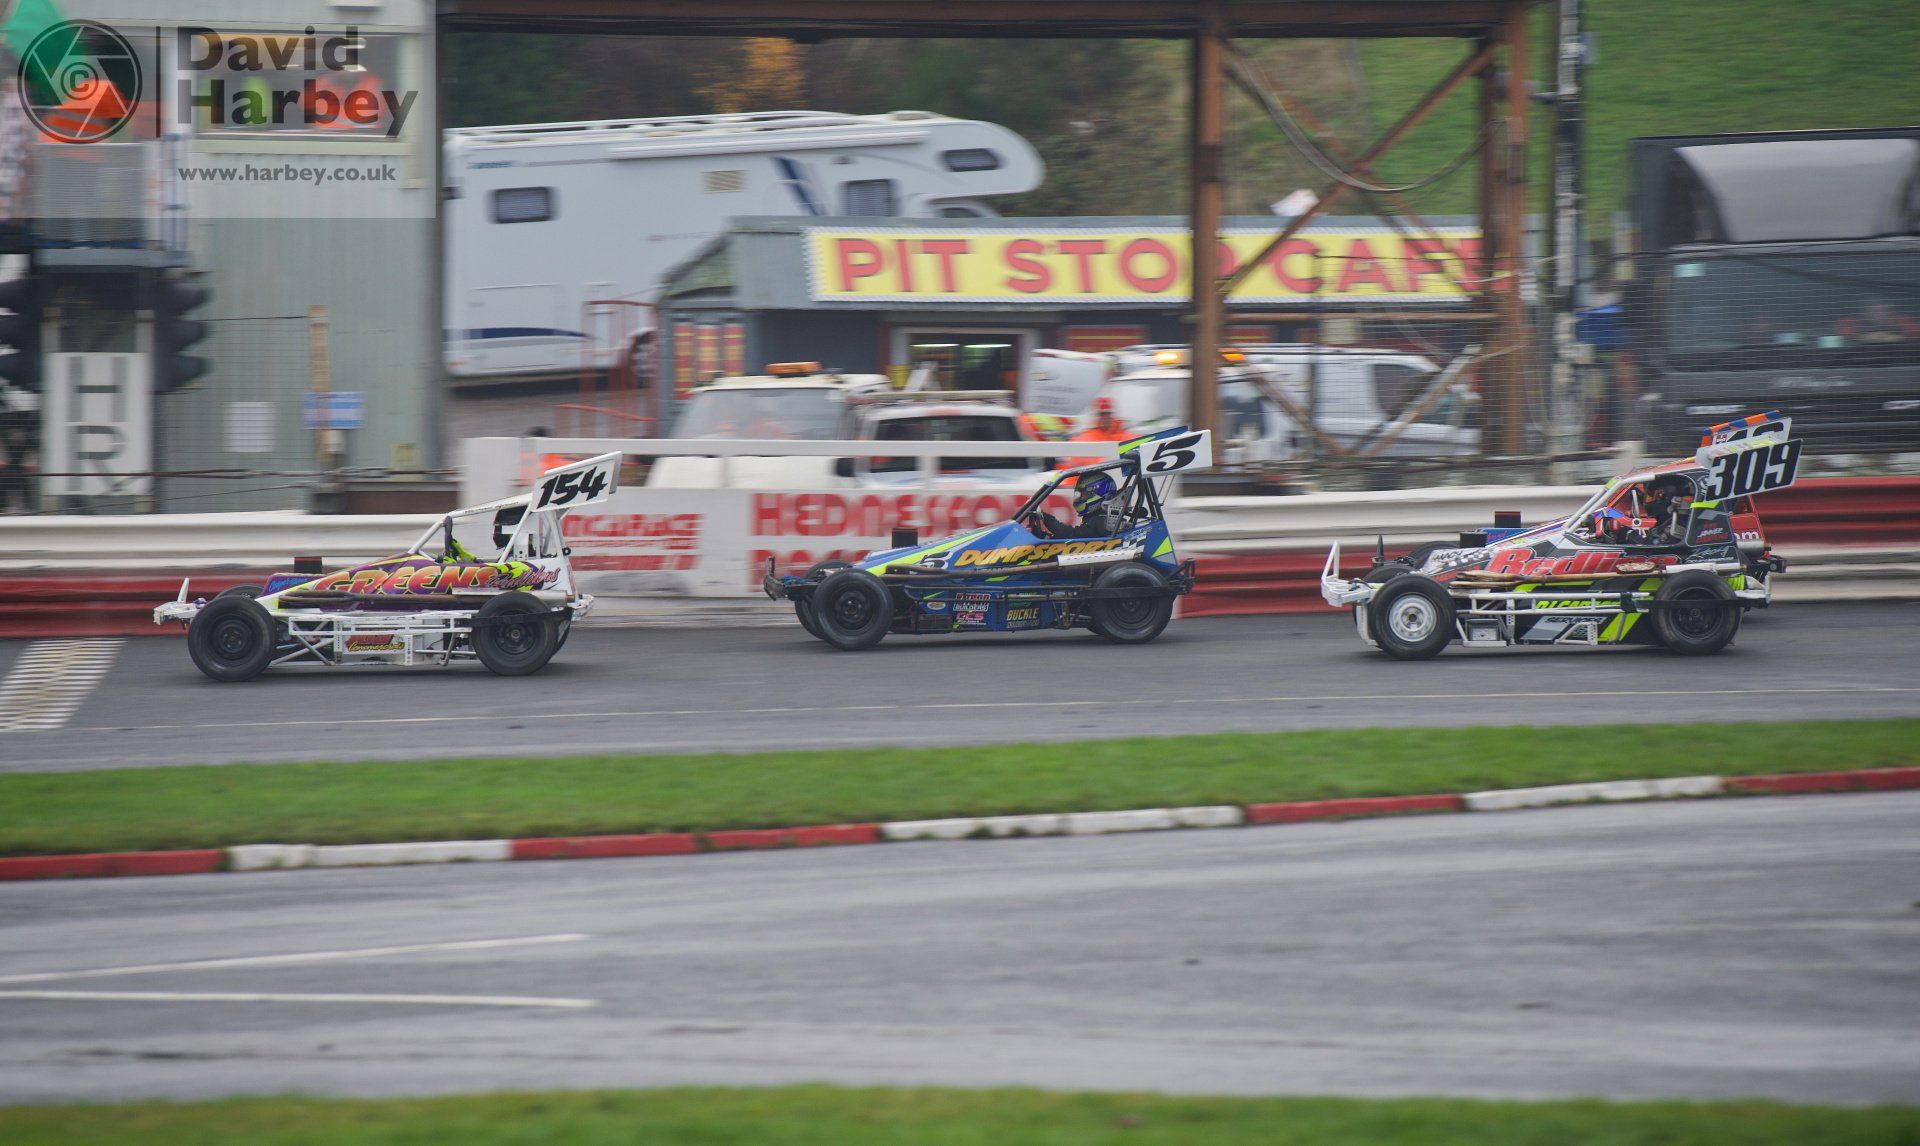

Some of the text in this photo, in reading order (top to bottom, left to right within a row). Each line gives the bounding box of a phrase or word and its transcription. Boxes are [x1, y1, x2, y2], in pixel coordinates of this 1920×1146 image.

[834, 238, 972, 293] PIT
[1146, 434, 1203, 472] 5
[1705, 439, 1802, 501] 309
[537, 466, 608, 509] 154
[954, 538, 1122, 567] DUMPSPORT
[313, 565, 498, 595] GREENS
[1006, 608, 1040, 621] BUCKLE
